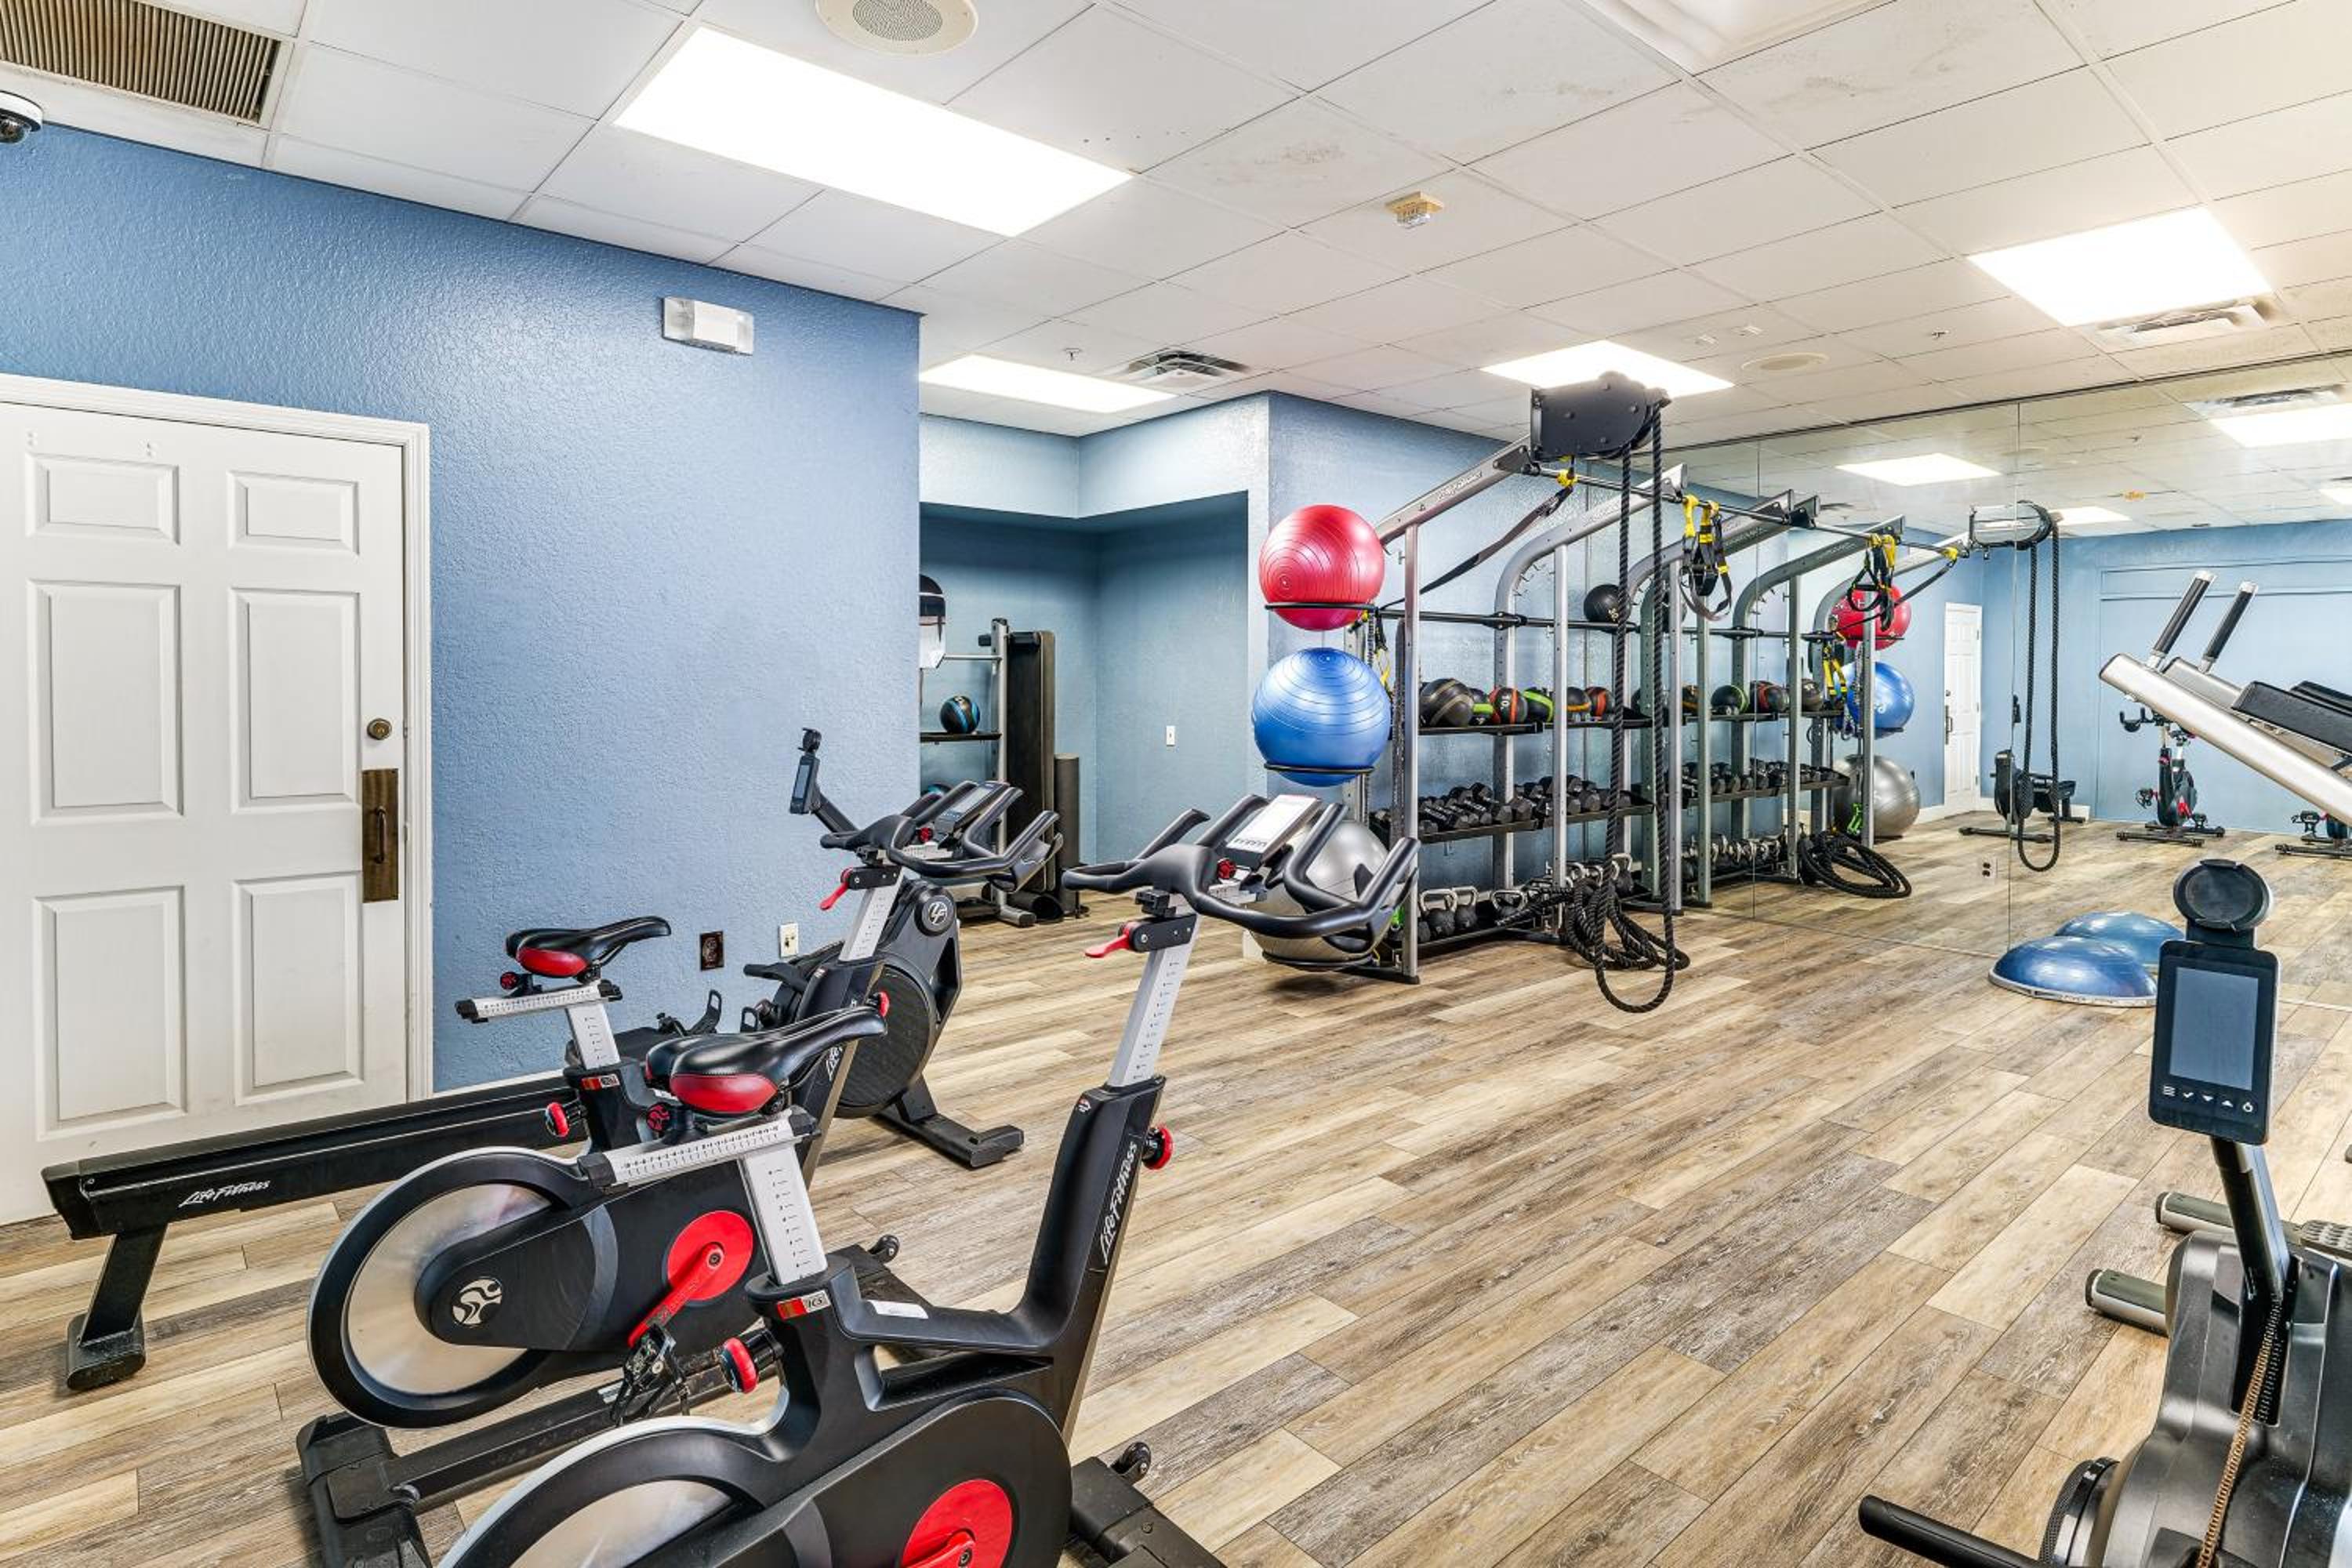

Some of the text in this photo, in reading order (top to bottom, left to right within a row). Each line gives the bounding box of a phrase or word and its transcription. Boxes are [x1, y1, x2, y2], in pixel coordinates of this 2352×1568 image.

[177, 1180, 271, 1208] Life Fitness
[1099, 1141, 1138, 1265] Life Fitness
